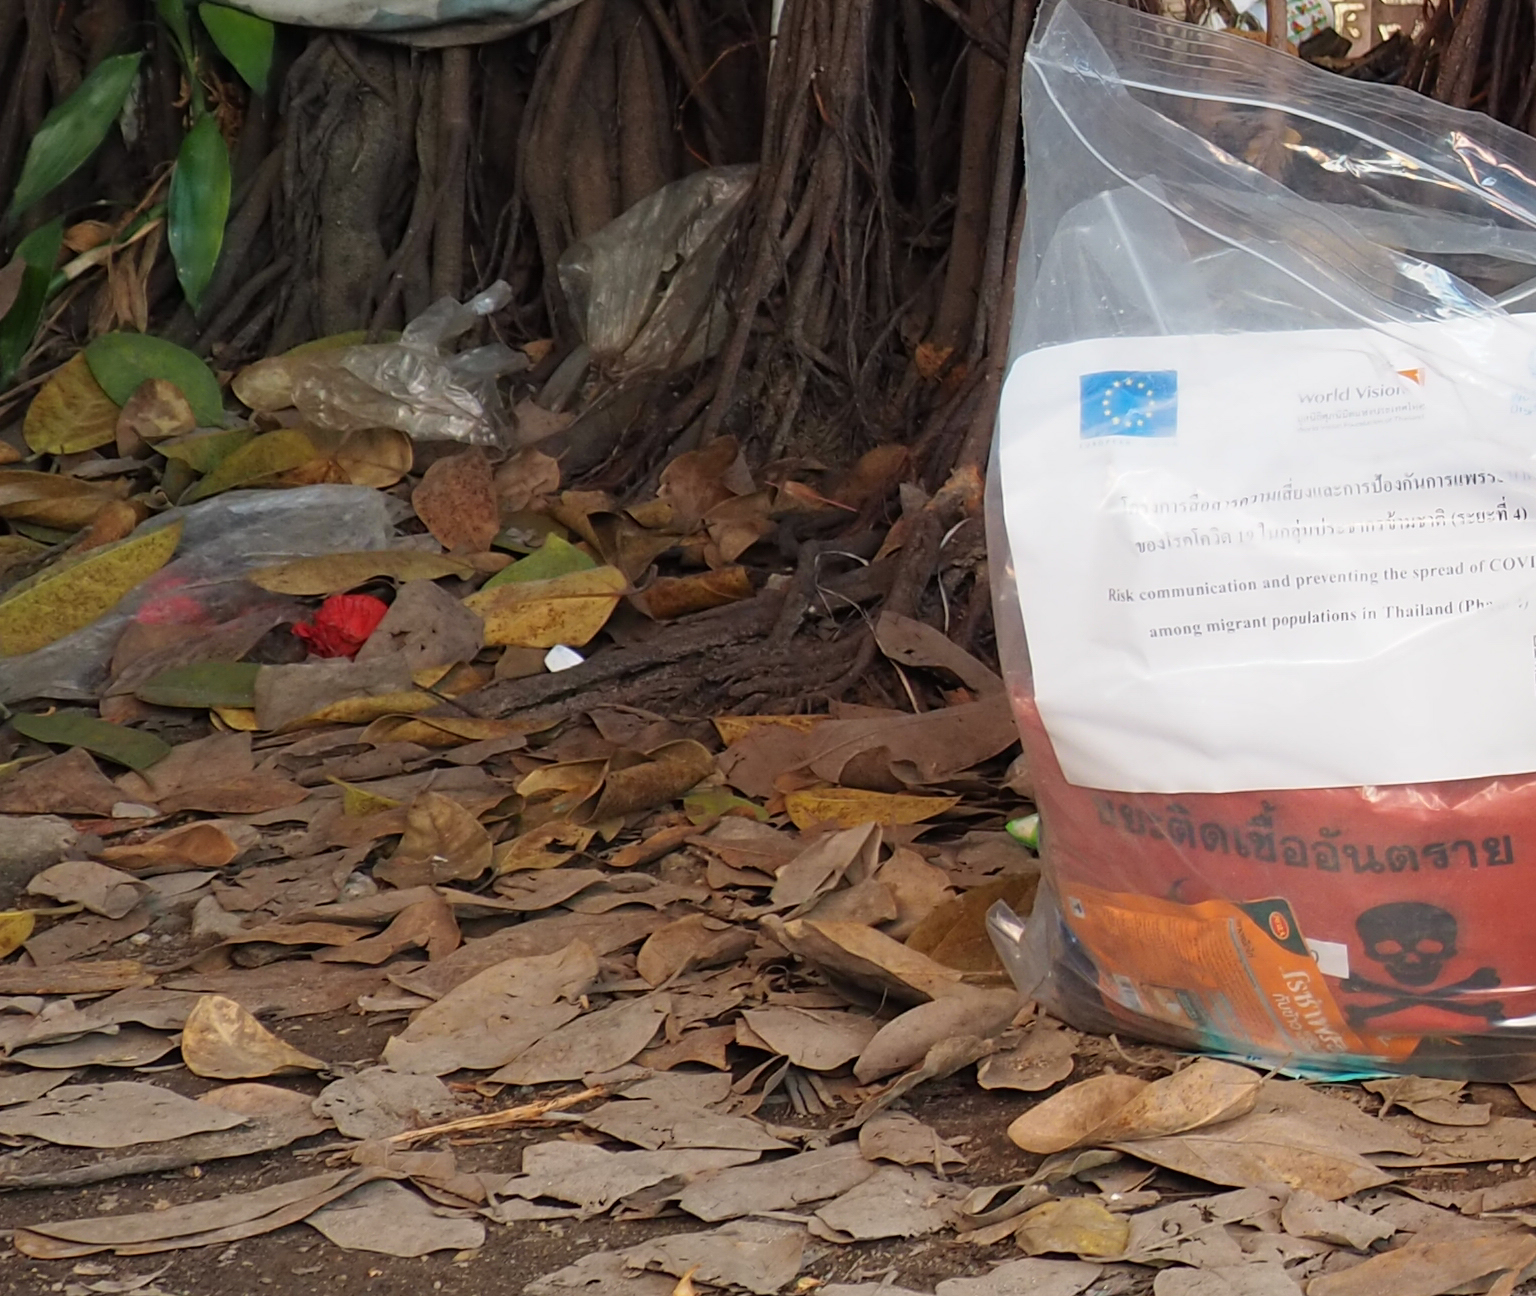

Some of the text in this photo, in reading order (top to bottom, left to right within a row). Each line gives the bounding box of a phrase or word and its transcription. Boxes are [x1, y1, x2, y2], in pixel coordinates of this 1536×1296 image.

[1107, 587, 1135, 603] Risk
[1139, 579, 1257, 601] communication
[1262, 574, 1291, 590] and
[1296, 569, 1379, 590] preventing
[1383, 566, 1408, 581] the
[1413, 561, 1464, 582] spread
[1469, 559, 1487, 574] of
[1149, 623, 1203, 638] among
[1206, 615, 1268, 634] migrant
[1271, 609, 1357, 630] populations
[1362, 606, 1378, 621] in
[1385, 600, 1454, 620] Thailand
